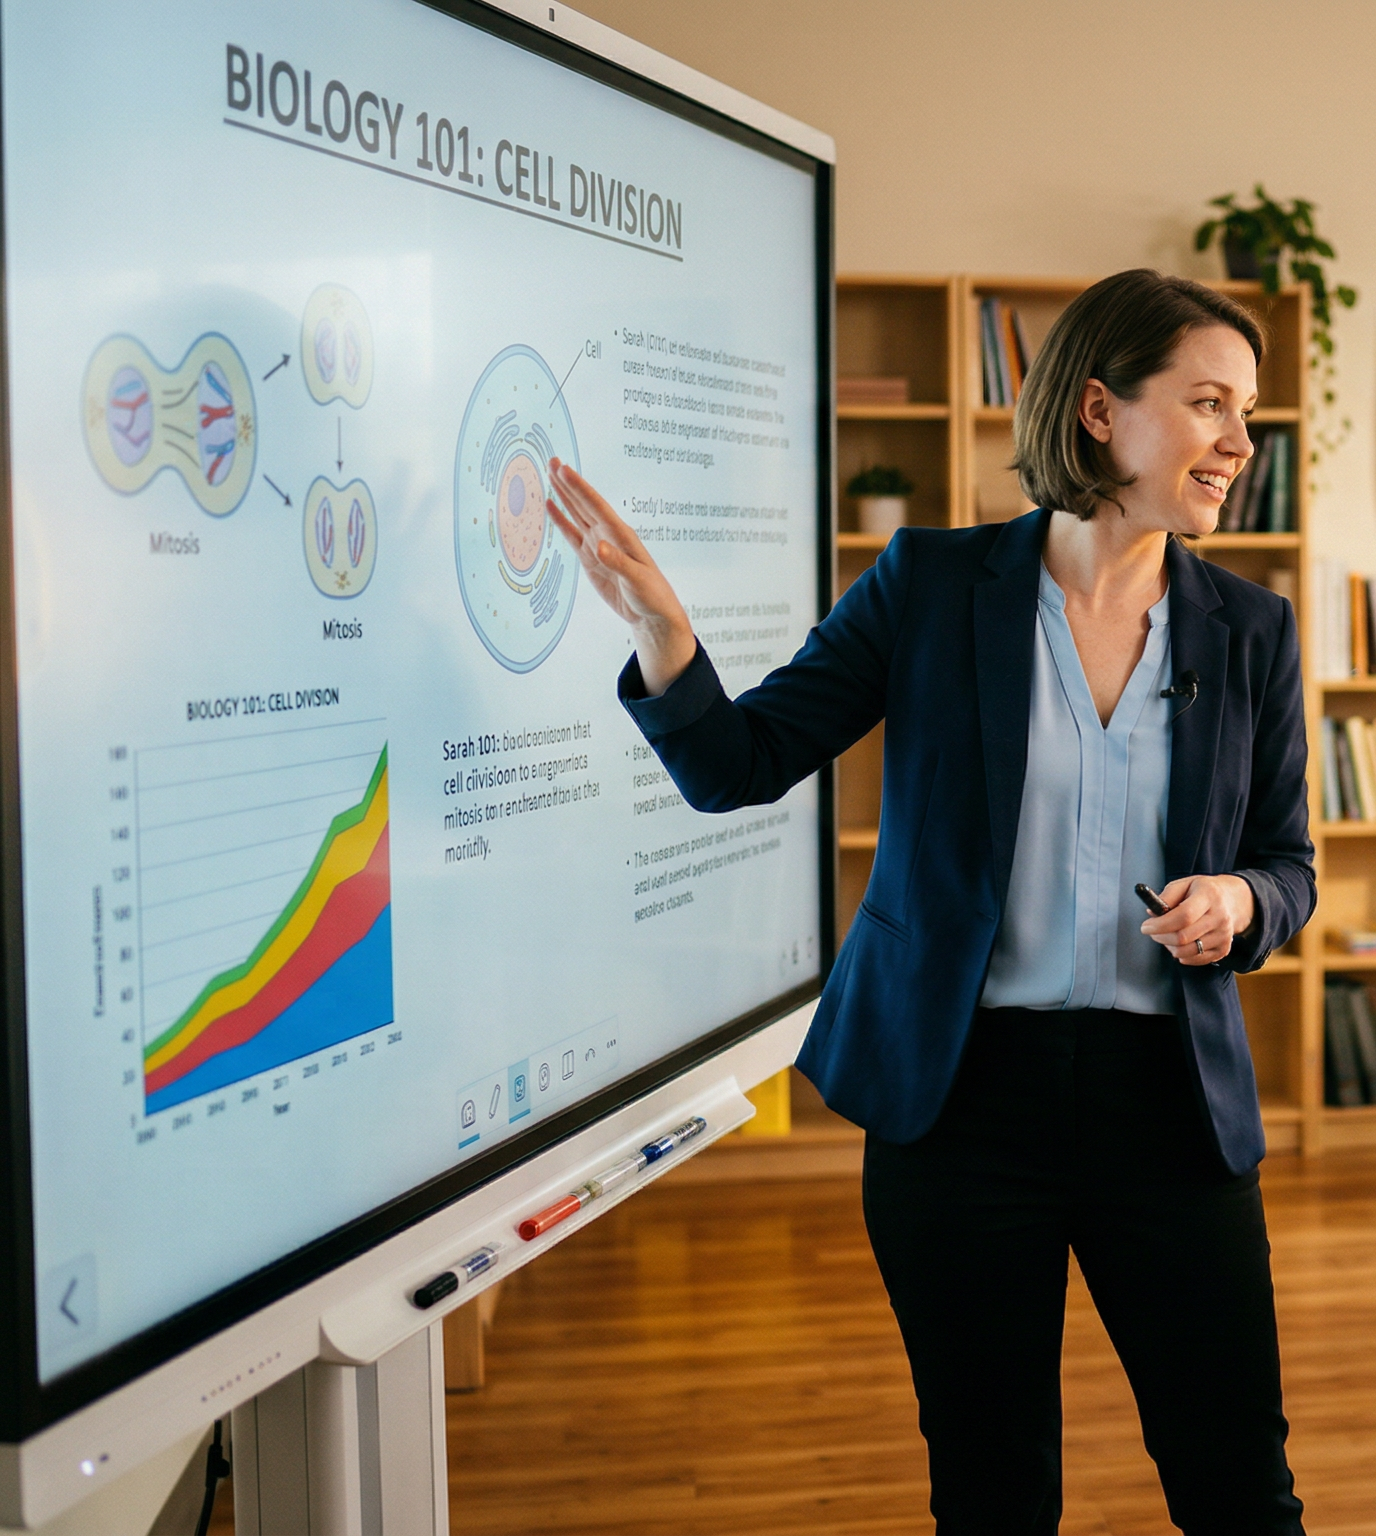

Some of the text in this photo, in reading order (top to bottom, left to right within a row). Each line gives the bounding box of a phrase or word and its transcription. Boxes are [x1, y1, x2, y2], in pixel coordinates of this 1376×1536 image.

[226, 43, 683, 250] BIOLOGY 101: CELL DIVISION
[585, 339, 602, 360] Cell
[149, 530, 201, 555] Mitosis
[322, 617, 363, 640] Mitosis
[187, 687, 340, 722] BIOLOGY 101: CELL DIVISION
[443, 735, 475, 761] Sarah
[478, 733, 501, 756] 101:
[443, 770, 463, 796] cell
[519, 763, 530, 782] to
[444, 803, 483, 831] mitosis
